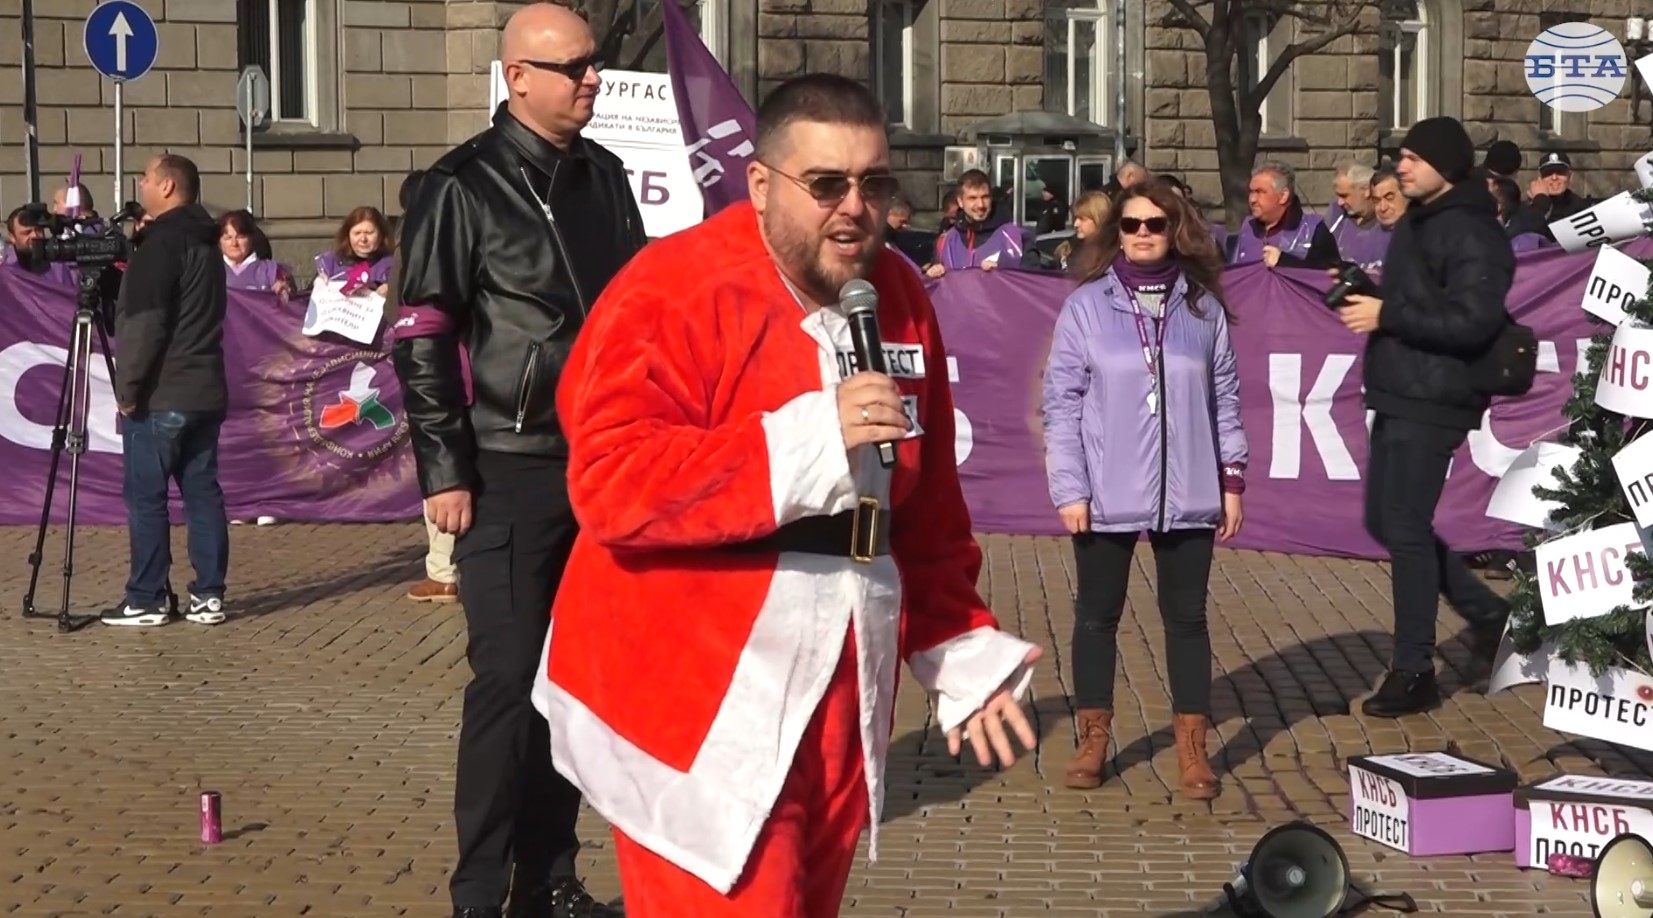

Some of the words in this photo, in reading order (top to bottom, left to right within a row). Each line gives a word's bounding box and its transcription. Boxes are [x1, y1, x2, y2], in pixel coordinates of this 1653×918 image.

[836, 348, 919, 377] ПРЕСТ
[1551, 684, 1653, 727] ПРОТЕС
[1357, 769, 1397, 808] КНСБ
[1356, 806, 1407, 847] ПРОТЕСТ
[1550, 802, 1630, 837] КНСБ
